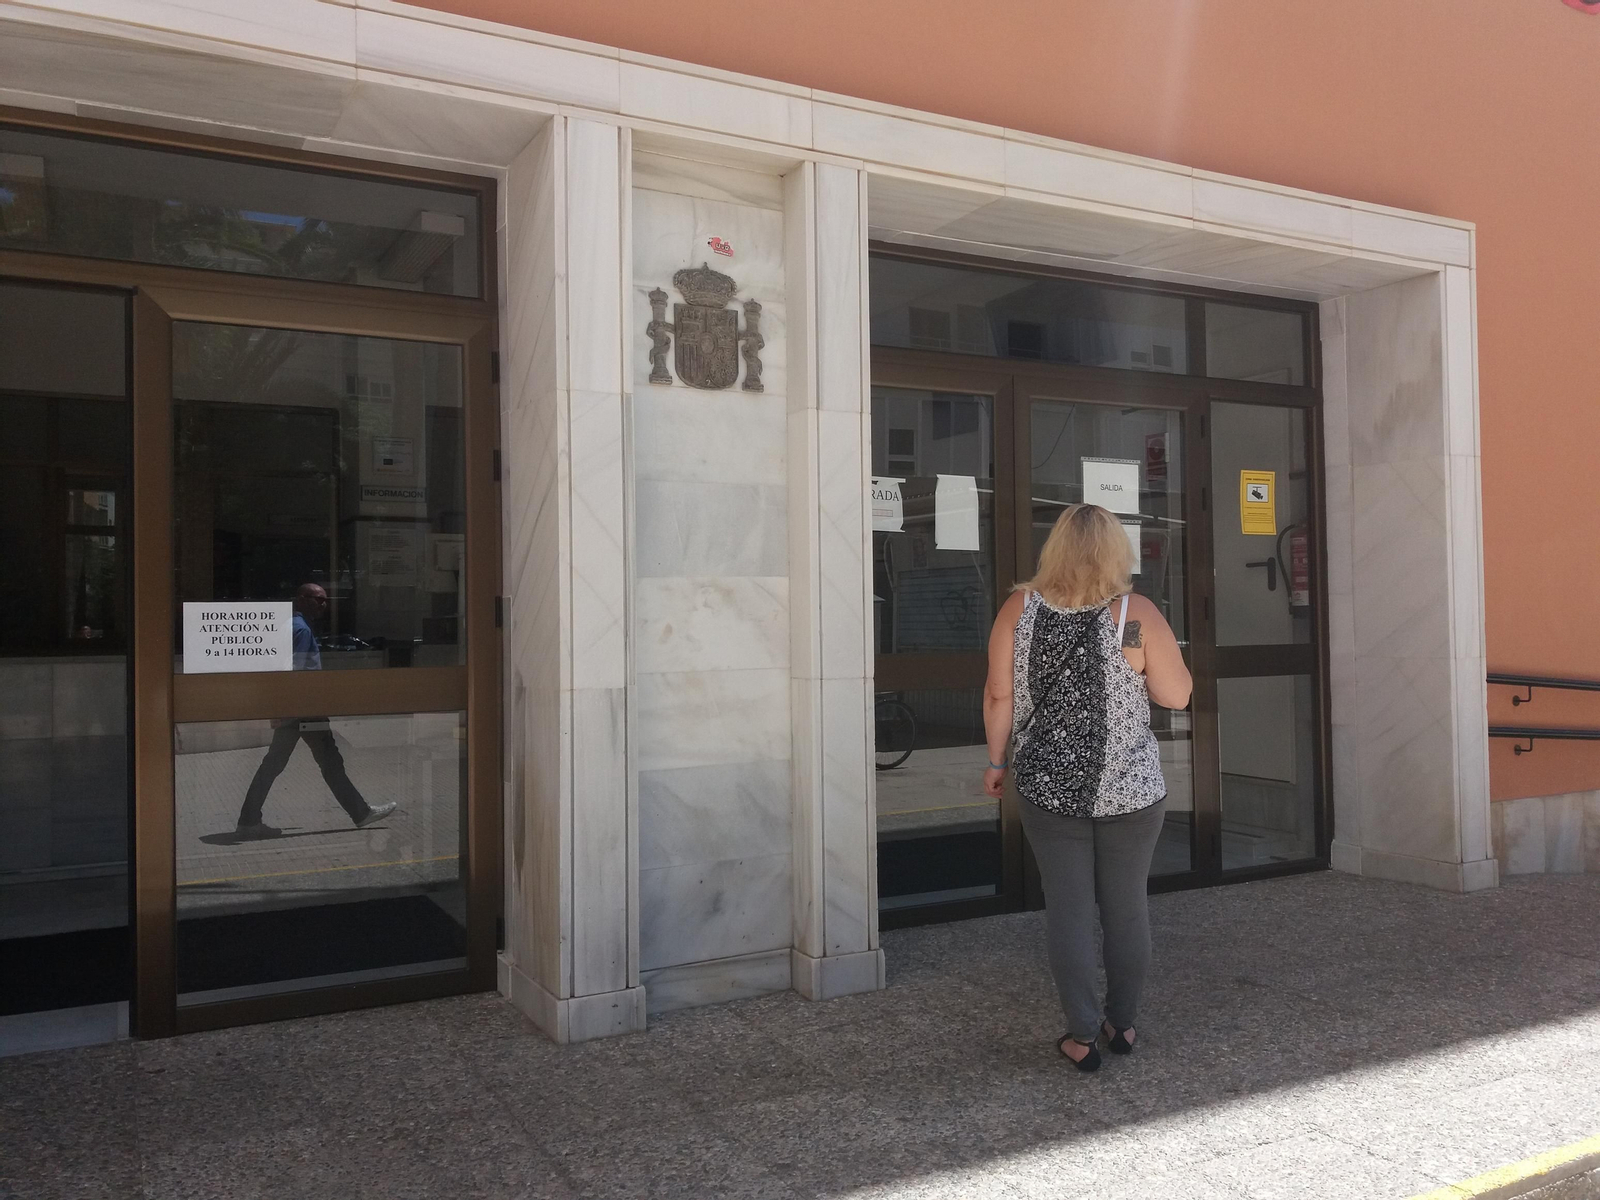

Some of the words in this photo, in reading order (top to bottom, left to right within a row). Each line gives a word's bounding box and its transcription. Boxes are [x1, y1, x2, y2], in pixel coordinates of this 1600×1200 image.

[1100, 483, 1123, 492] SALIDA
[364, 489, 424, 499] INFORMACION
[201, 612, 257, 620] HORARIO
[260, 612, 275, 620] DE
[199, 622, 260, 632] ATENCIÓN
[262, 624, 277, 632] AL
[211, 634, 263, 644] PÚBLICO
[205, 648, 212, 657] 9
[223, 648, 234, 657] 14
[237, 648, 277, 656] HORAS
